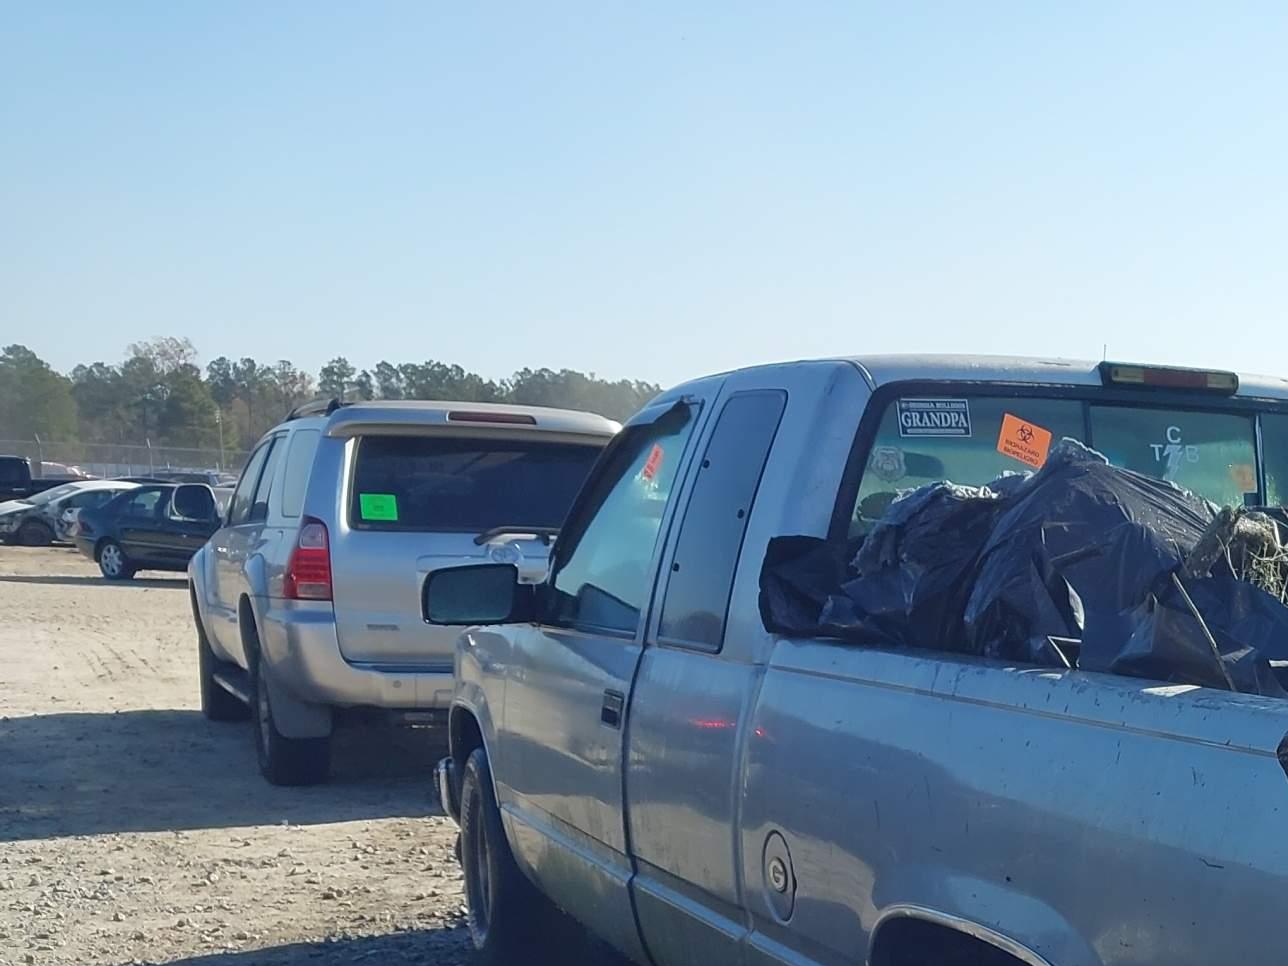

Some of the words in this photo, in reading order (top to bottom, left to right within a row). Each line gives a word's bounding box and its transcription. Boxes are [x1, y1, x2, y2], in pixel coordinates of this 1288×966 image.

[901, 411, 968, 428] GRANDPA
[1166, 425, 1182, 444] C
[1149, 444, 1163, 462] T
[1185, 445, 1200, 463] B
